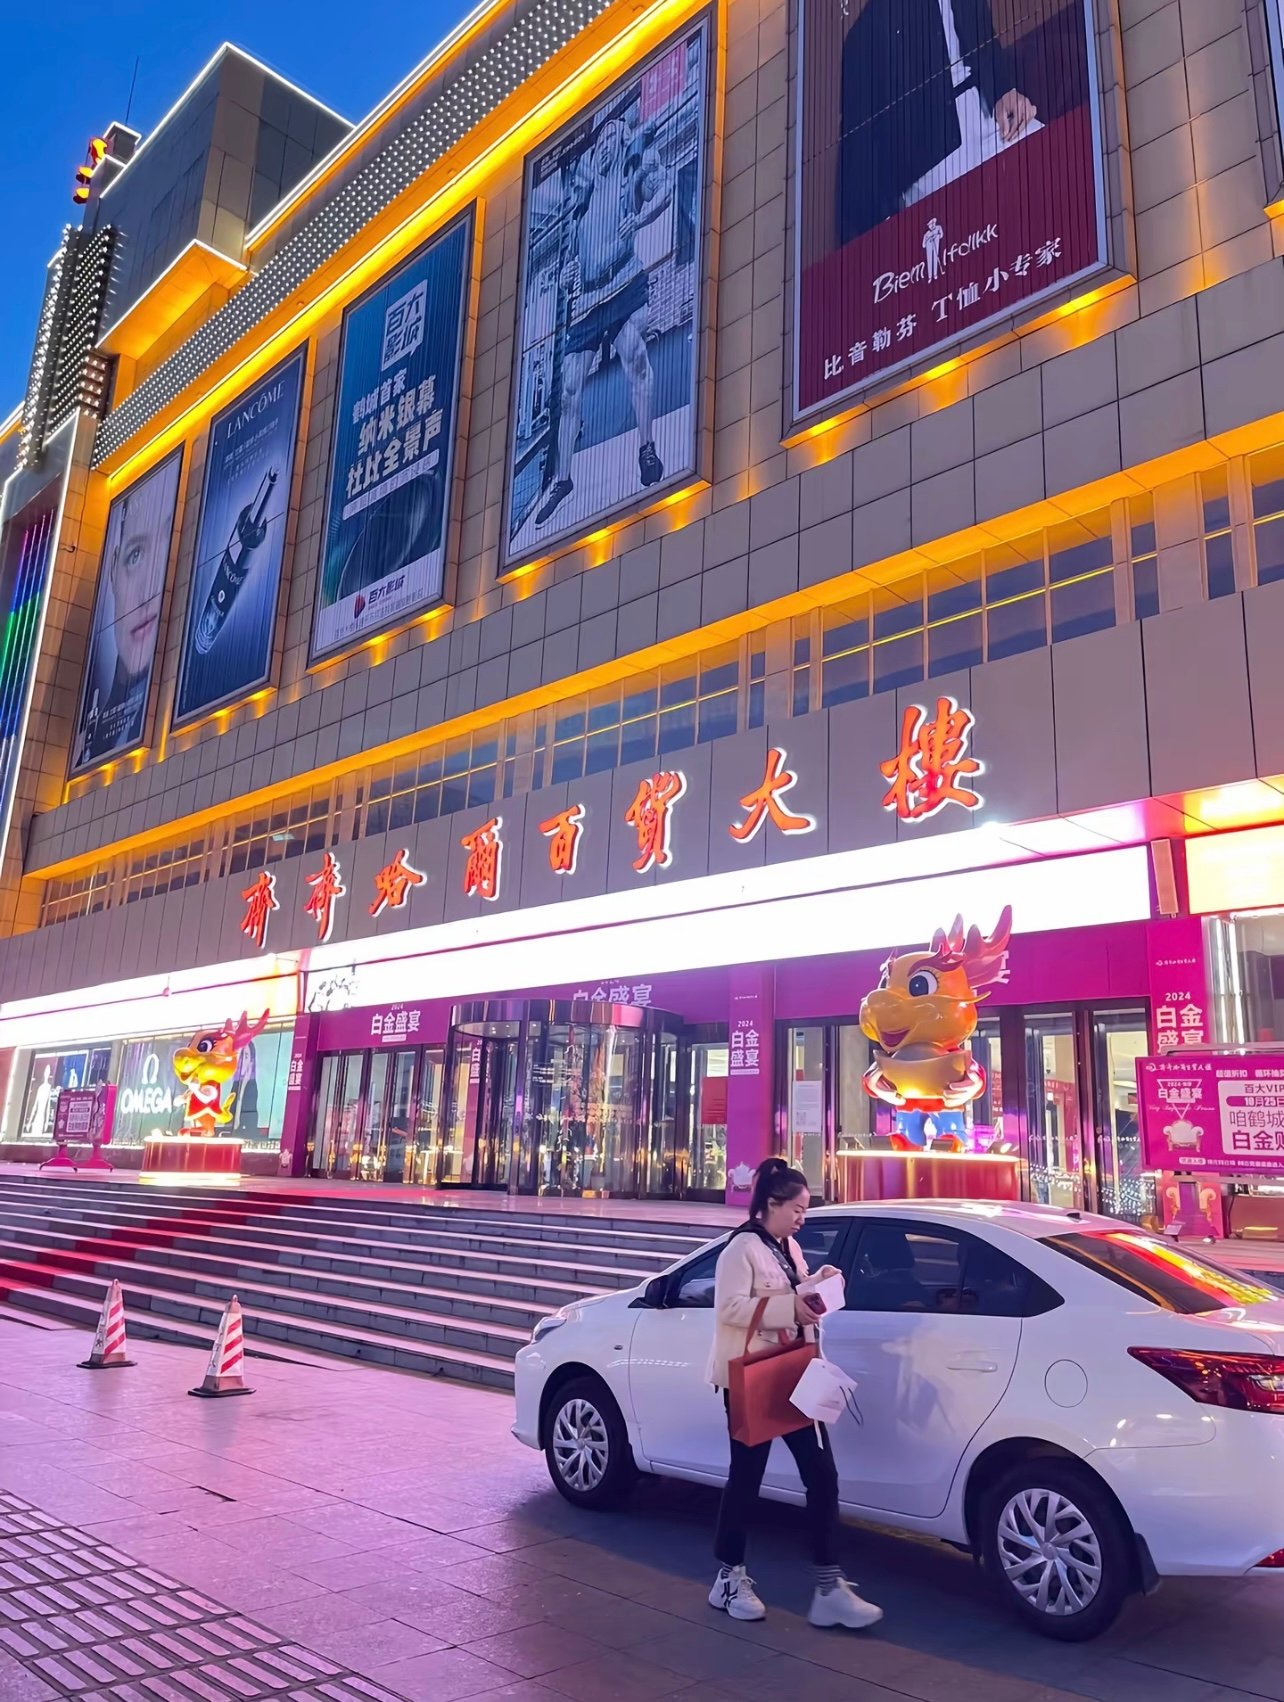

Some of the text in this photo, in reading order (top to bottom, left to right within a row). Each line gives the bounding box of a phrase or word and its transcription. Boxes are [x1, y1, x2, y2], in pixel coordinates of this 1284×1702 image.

[823, 313, 917, 380] 比音勒芬
[358, 374, 436, 456] 纳米银幕
[346, 408, 443, 499] 杜比全景声
[1165, 992, 1191, 1001] 2024
[371, 1009, 420, 1035] 白金盛宴
[737, 1020, 753, 1028] 2024
[1156, 1003, 1203, 1029] 白金
[731, 1029, 759, 1048] 白金
[730, 1048, 759, 1067] 盛宴
[121, 1087, 173, 1114] OMEGA
